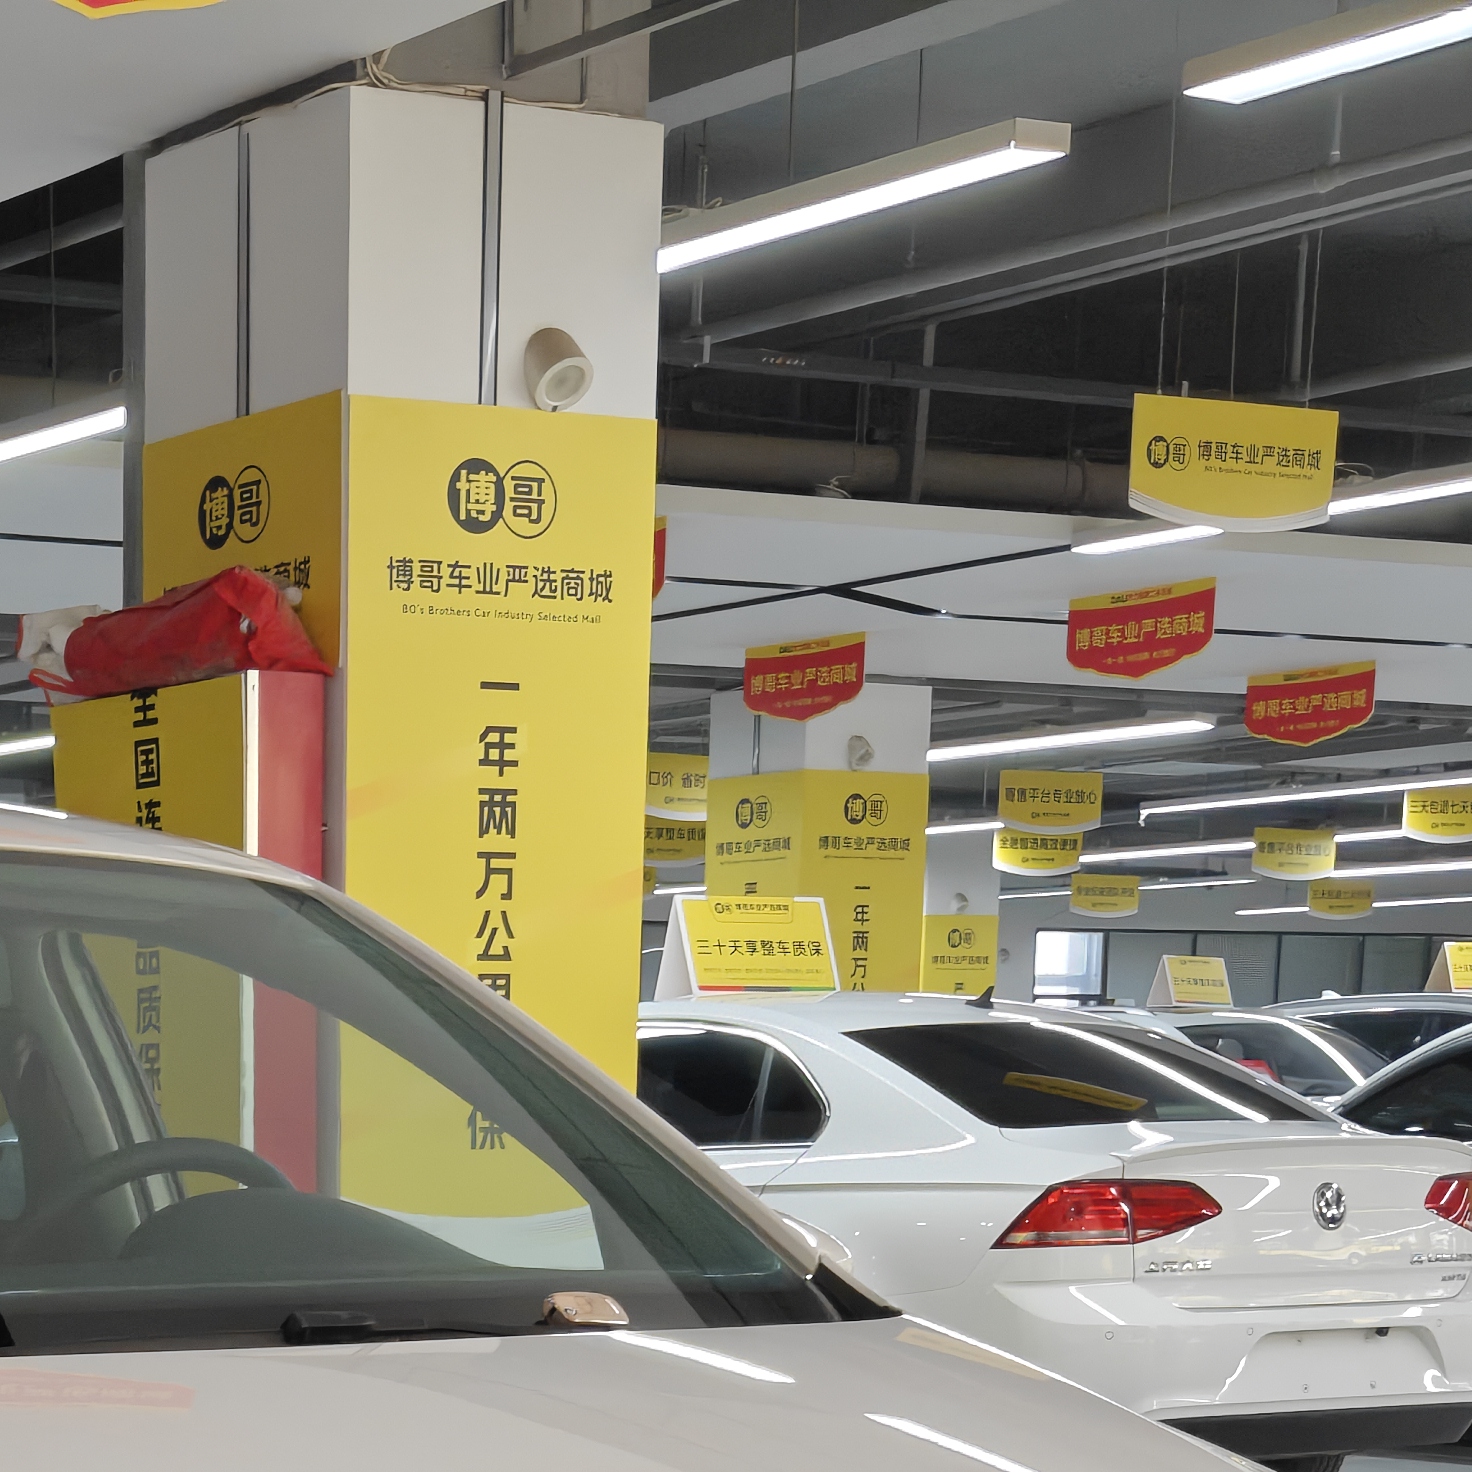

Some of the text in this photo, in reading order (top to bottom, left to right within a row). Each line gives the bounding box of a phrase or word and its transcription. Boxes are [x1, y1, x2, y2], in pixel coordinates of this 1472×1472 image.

[1198, 439, 1322, 471] 博哥车业严选商城
[200, 471, 267, 544] 博哥
[452, 463, 551, 532] 博哥
[387, 556, 613, 603] 博哥车业严选商城
[428, 605, 471, 617] Brothers
[474, 608, 490, 618] Car
[494, 609, 534, 622] Industry
[537, 611, 578, 623] Selected
[696, 939, 824, 957] 三十天享整车质保
